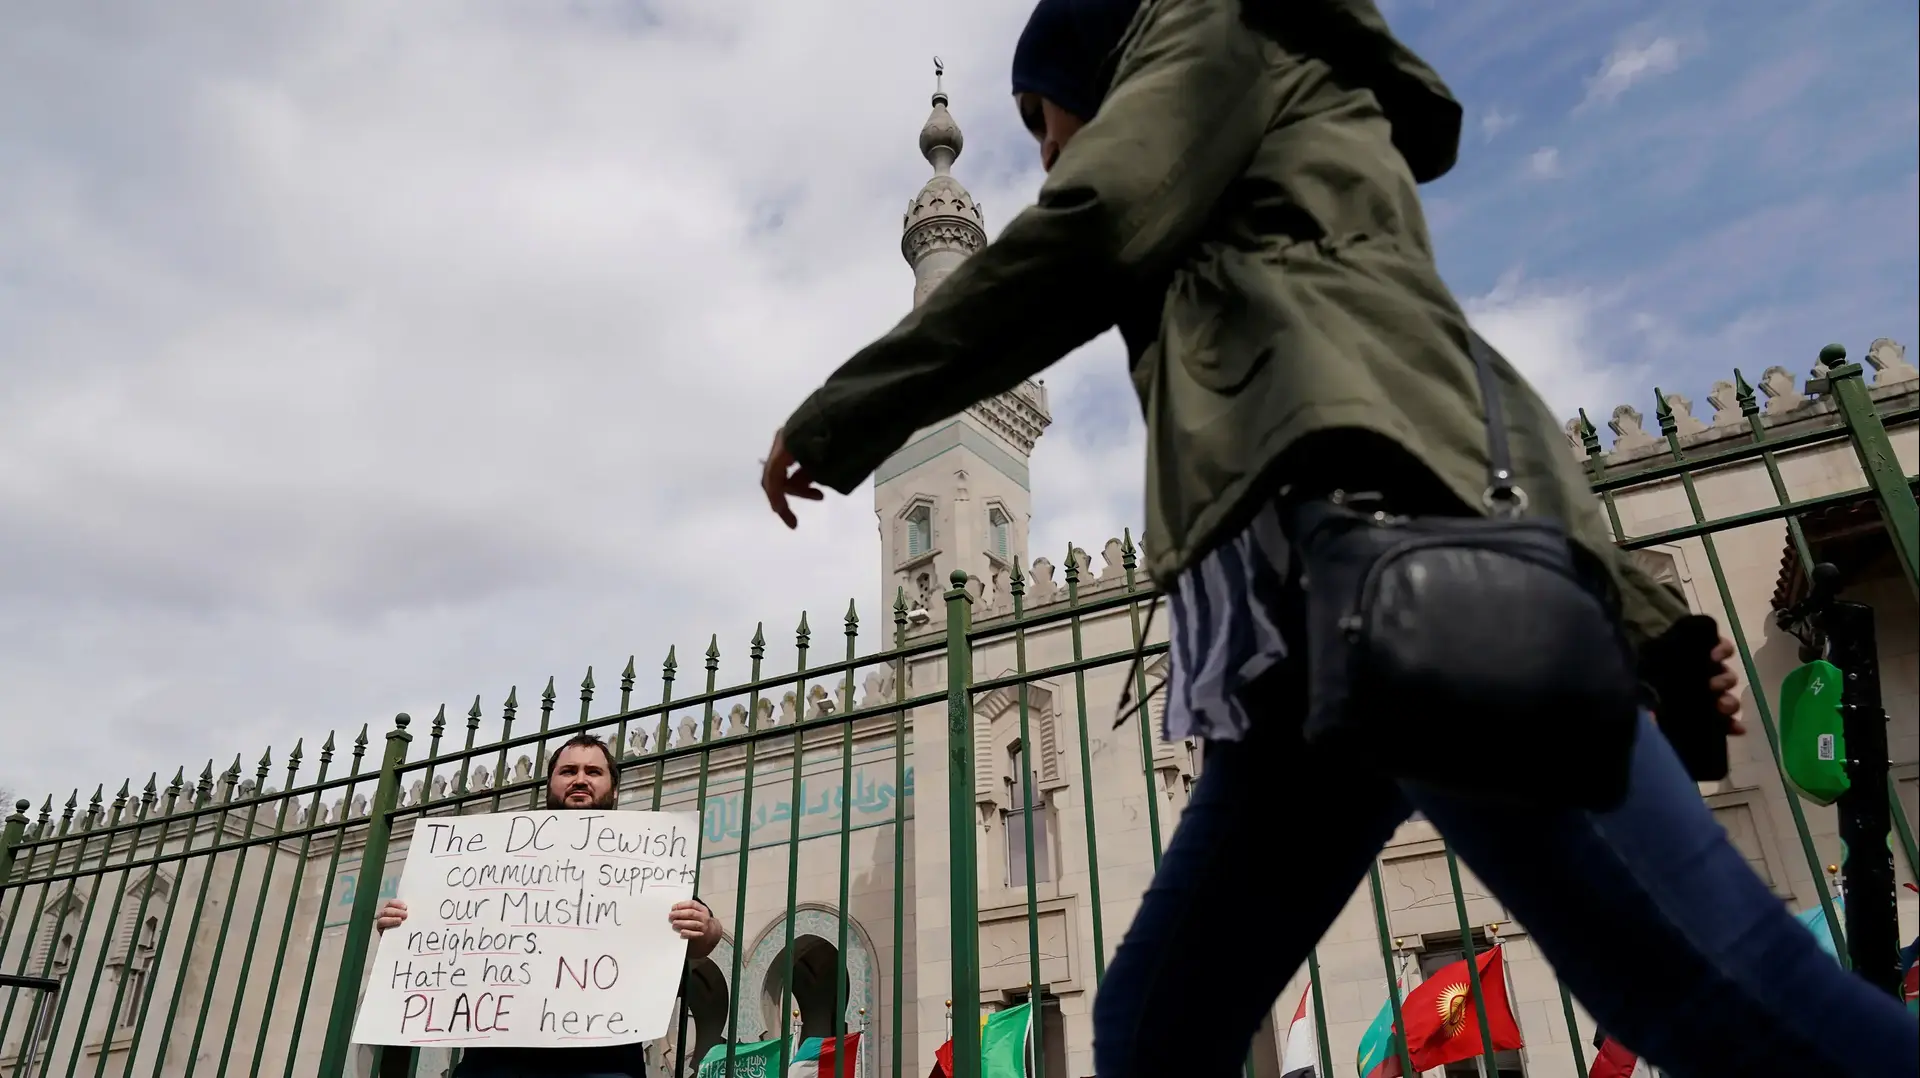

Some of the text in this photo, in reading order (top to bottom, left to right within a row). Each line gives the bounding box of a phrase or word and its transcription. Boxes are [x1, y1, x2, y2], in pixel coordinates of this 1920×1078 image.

[427, 815, 688, 858] The DC Jewish
[446, 858, 696, 896] community supports
[439, 889, 622, 927] our Muslim
[407, 927, 543, 966] neighbors.
[391, 954, 620, 991] Hate has NO
[400, 992, 639, 1035] PLACE here.
